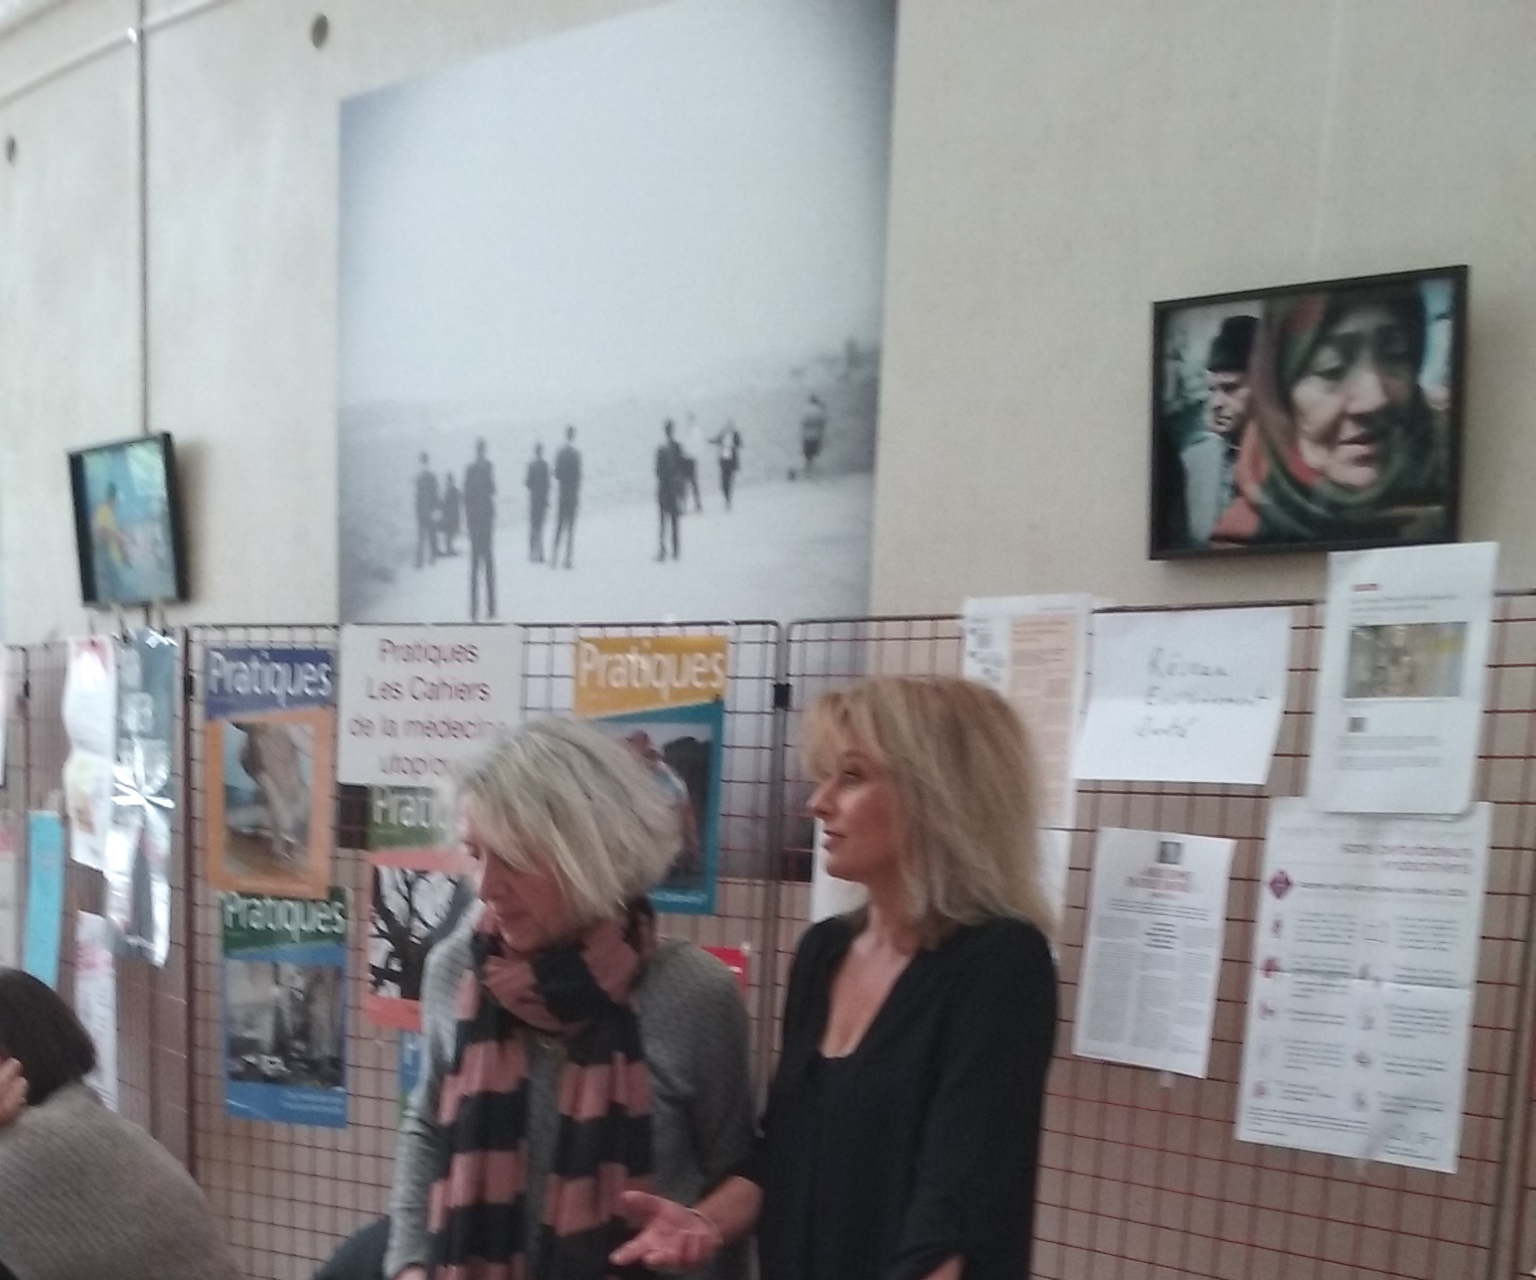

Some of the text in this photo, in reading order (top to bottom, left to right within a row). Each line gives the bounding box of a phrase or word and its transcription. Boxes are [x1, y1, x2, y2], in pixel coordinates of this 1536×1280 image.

[378, 638, 479, 667] Pratiques
[577, 639, 725, 700] Pratiques
[208, 650, 333, 708] Pratiques
[366, 675, 491, 701] Les Cahiers
[349, 713, 376, 737] de
[379, 713, 399, 737] la
[223, 891, 346, 942] Pratiques
